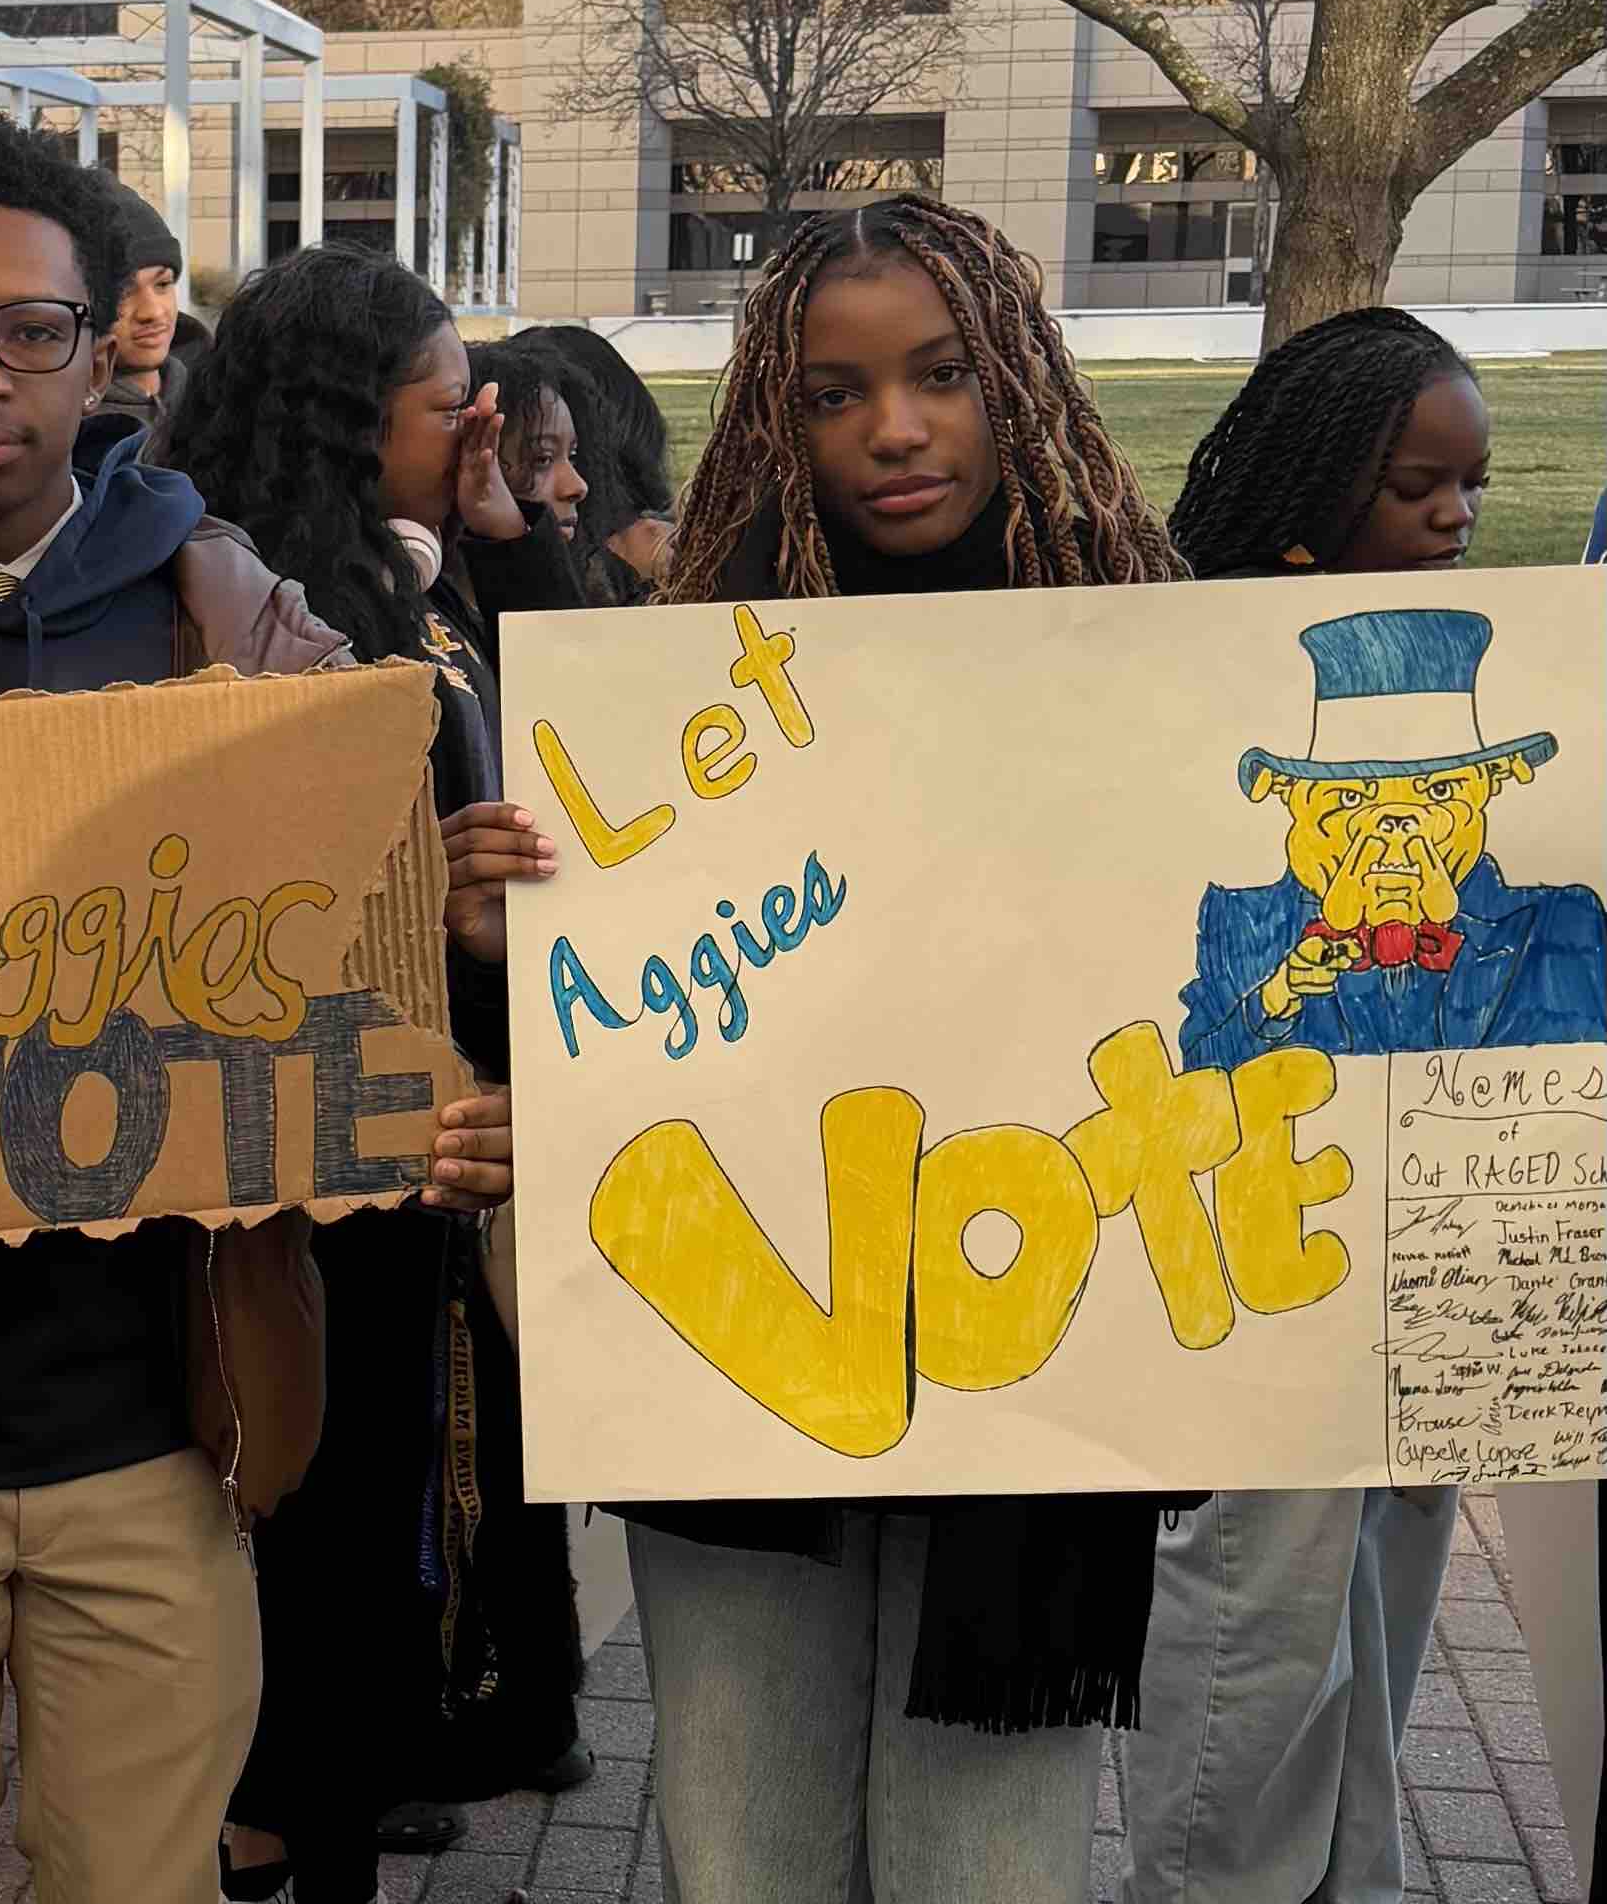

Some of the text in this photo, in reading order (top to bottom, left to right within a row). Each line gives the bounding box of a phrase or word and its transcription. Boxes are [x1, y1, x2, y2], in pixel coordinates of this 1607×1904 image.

[532, 603, 816, 870] Let
[547, 849, 848, 1060] Aggies
[1498, 1120, 1520, 1142] of
[1492, 1219, 1550, 1245] Justin
